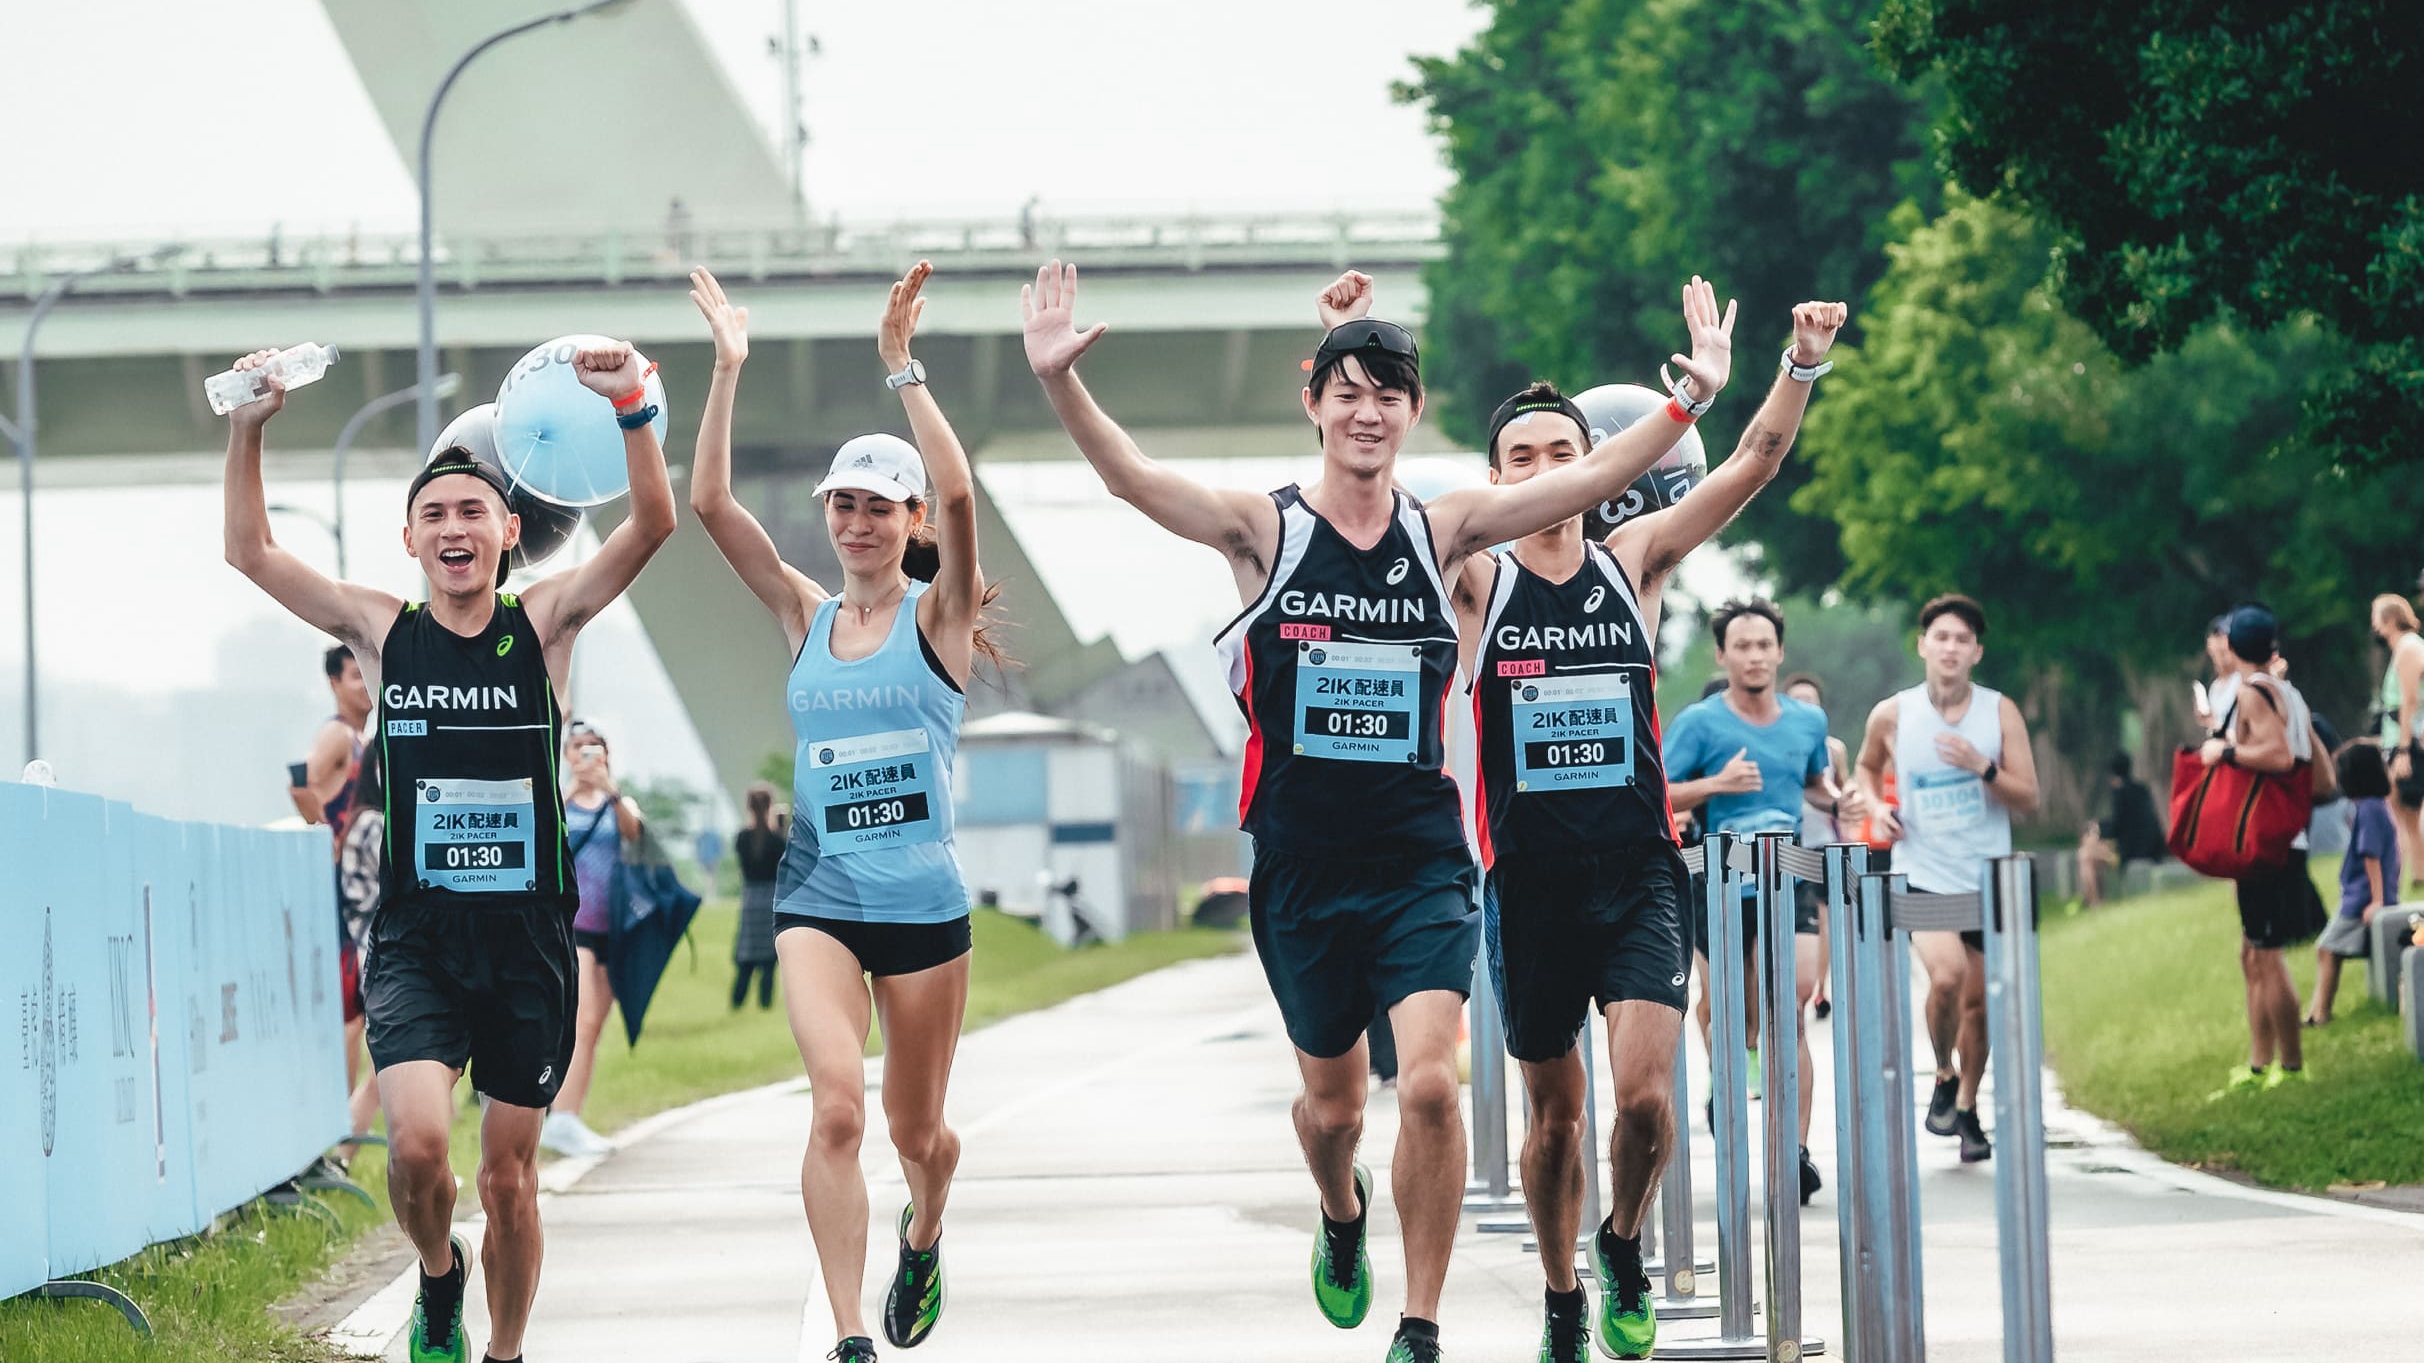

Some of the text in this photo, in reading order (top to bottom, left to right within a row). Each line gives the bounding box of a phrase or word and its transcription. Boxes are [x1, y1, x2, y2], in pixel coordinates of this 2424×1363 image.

[1600, 489, 1644, 524] 3
[1280, 590, 1425, 623] GARMIN
[1284, 625, 1327, 639] COACH
[1496, 622, 1632, 650] GARMIN
[1501, 662, 1541, 675] COACH
[1316, 677, 1404, 697] 21K 配速員
[384, 684, 518, 710] GARMIN
[792, 684, 920, 712] GARMIN
[1334, 698, 1384, 708] 21K PACER
[1327, 712, 1388, 736] 01:30
[1532, 707, 1618, 729] 21K 配速員
[391, 722, 423, 734] PACER
[1551, 728, 1600, 738] 21K PACER
[1332, 741, 1380, 752] GARMIN
[1547, 742, 1605, 766] 01:30
[830, 762, 917, 792] 21K 配速員
[1554, 771, 1599, 782] GARMIN
[849, 787, 897, 799] 21K PACER
[433, 812, 519, 830] 21K 配速員
[848, 800, 905, 827] 01:30
[450, 832, 497, 840] 21K PACER
[855, 830, 901, 843] GARMIN
[447, 847, 502, 867] 01:30
[452, 874, 497, 883] GARMIN
